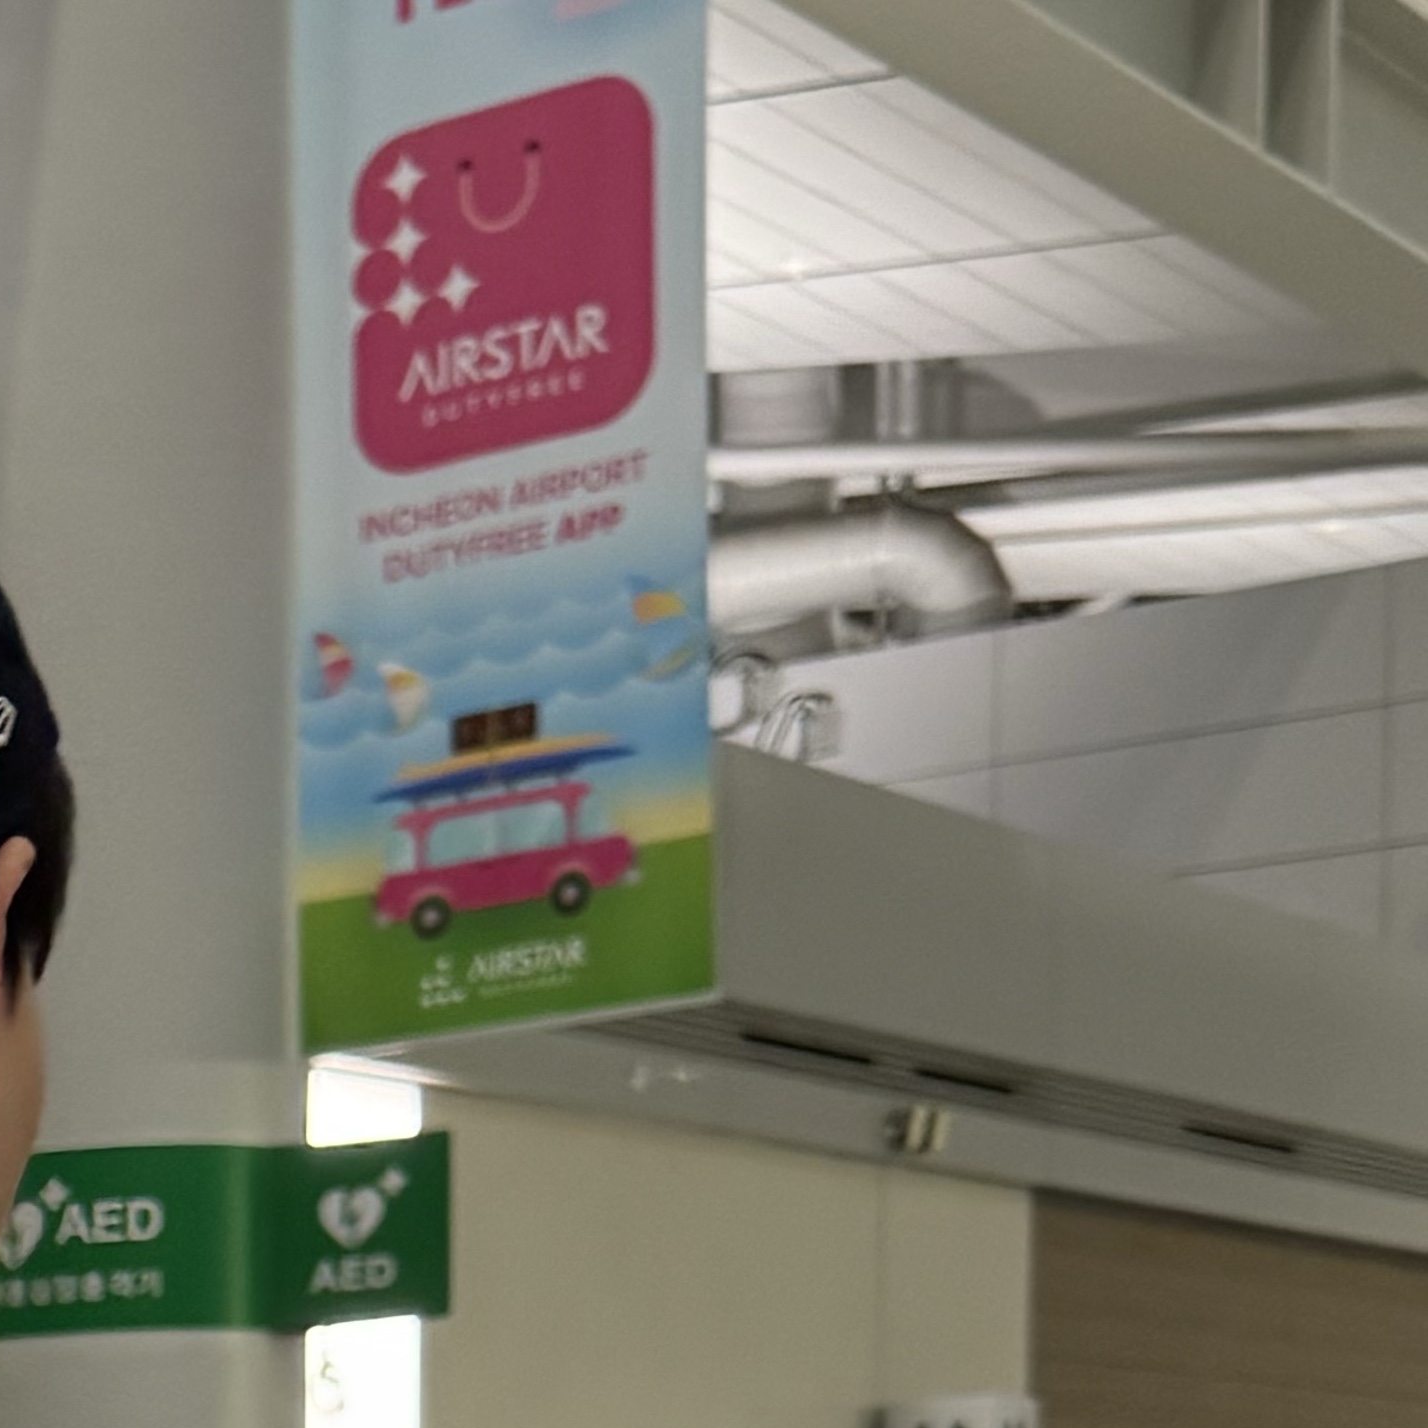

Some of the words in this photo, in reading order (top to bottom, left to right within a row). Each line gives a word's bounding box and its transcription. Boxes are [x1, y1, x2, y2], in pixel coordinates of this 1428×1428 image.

[398, 304, 610, 402] AIRSTAR
[358, 486, 503, 542] INCHEON
[510, 447, 649, 507] AIRPORT
[380, 519, 551, 583] DUTYFREE
[554, 502, 625, 545] APP
[54, 1195, 165, 1246] AED
[308, 1252, 399, 1295] AED
